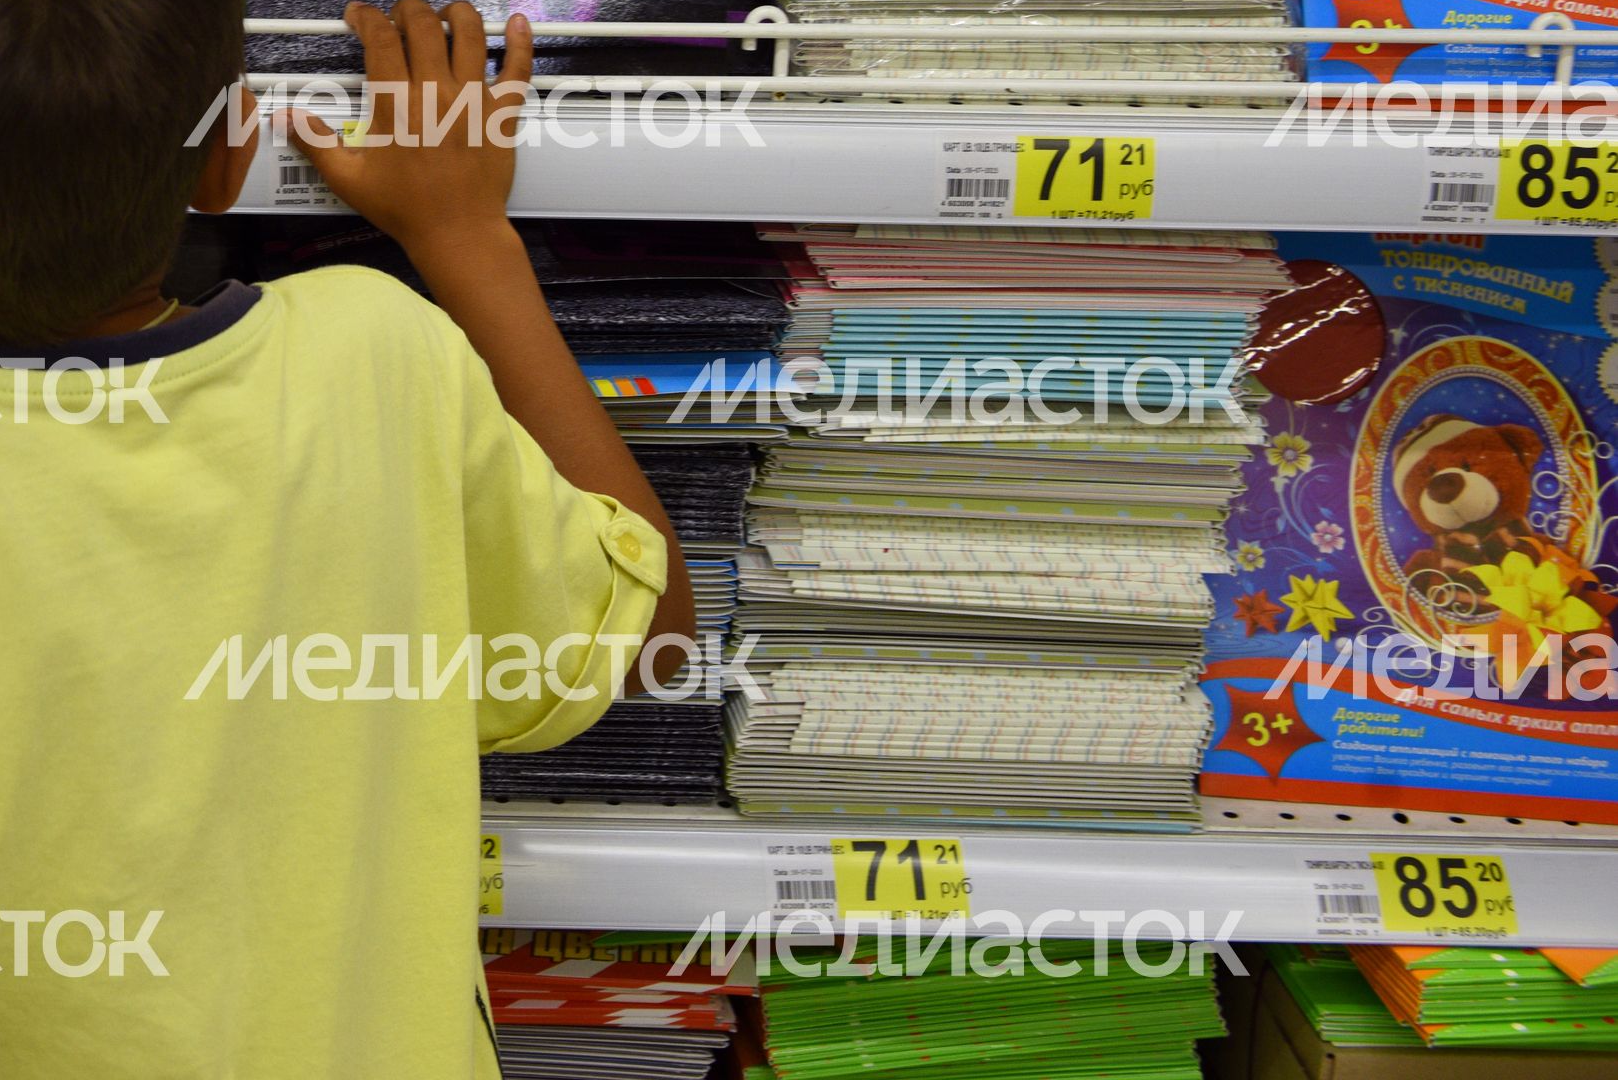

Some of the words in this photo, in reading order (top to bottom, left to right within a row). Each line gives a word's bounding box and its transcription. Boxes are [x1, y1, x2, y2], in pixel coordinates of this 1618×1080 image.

[1442, 10, 1513, 25] Дорогие
[1120, 144, 1145, 165] 21
[1034, 138, 1104, 201] 71
[1518, 144, 1600, 208] 85
[1120, 179, 1154, 199] руб
[1380, 249, 1575, 304] тонированный
[1333, 707, 1400, 723] Дорогие
[1440, 701, 1503, 724] самых
[1507, 711, 1566, 732] ярких
[1242, 711, 1294, 747] 3+
[1337, 722, 1425, 738] родители!
[479, 838, 496, 859] 2
[934, 844, 959, 864] 21
[851, 840, 927, 902] 71
[1474, 862, 1503, 882] 20
[479, 873, 504, 893] уб
[940, 878, 973, 897] руб
[1394, 856, 1478, 918] 85
